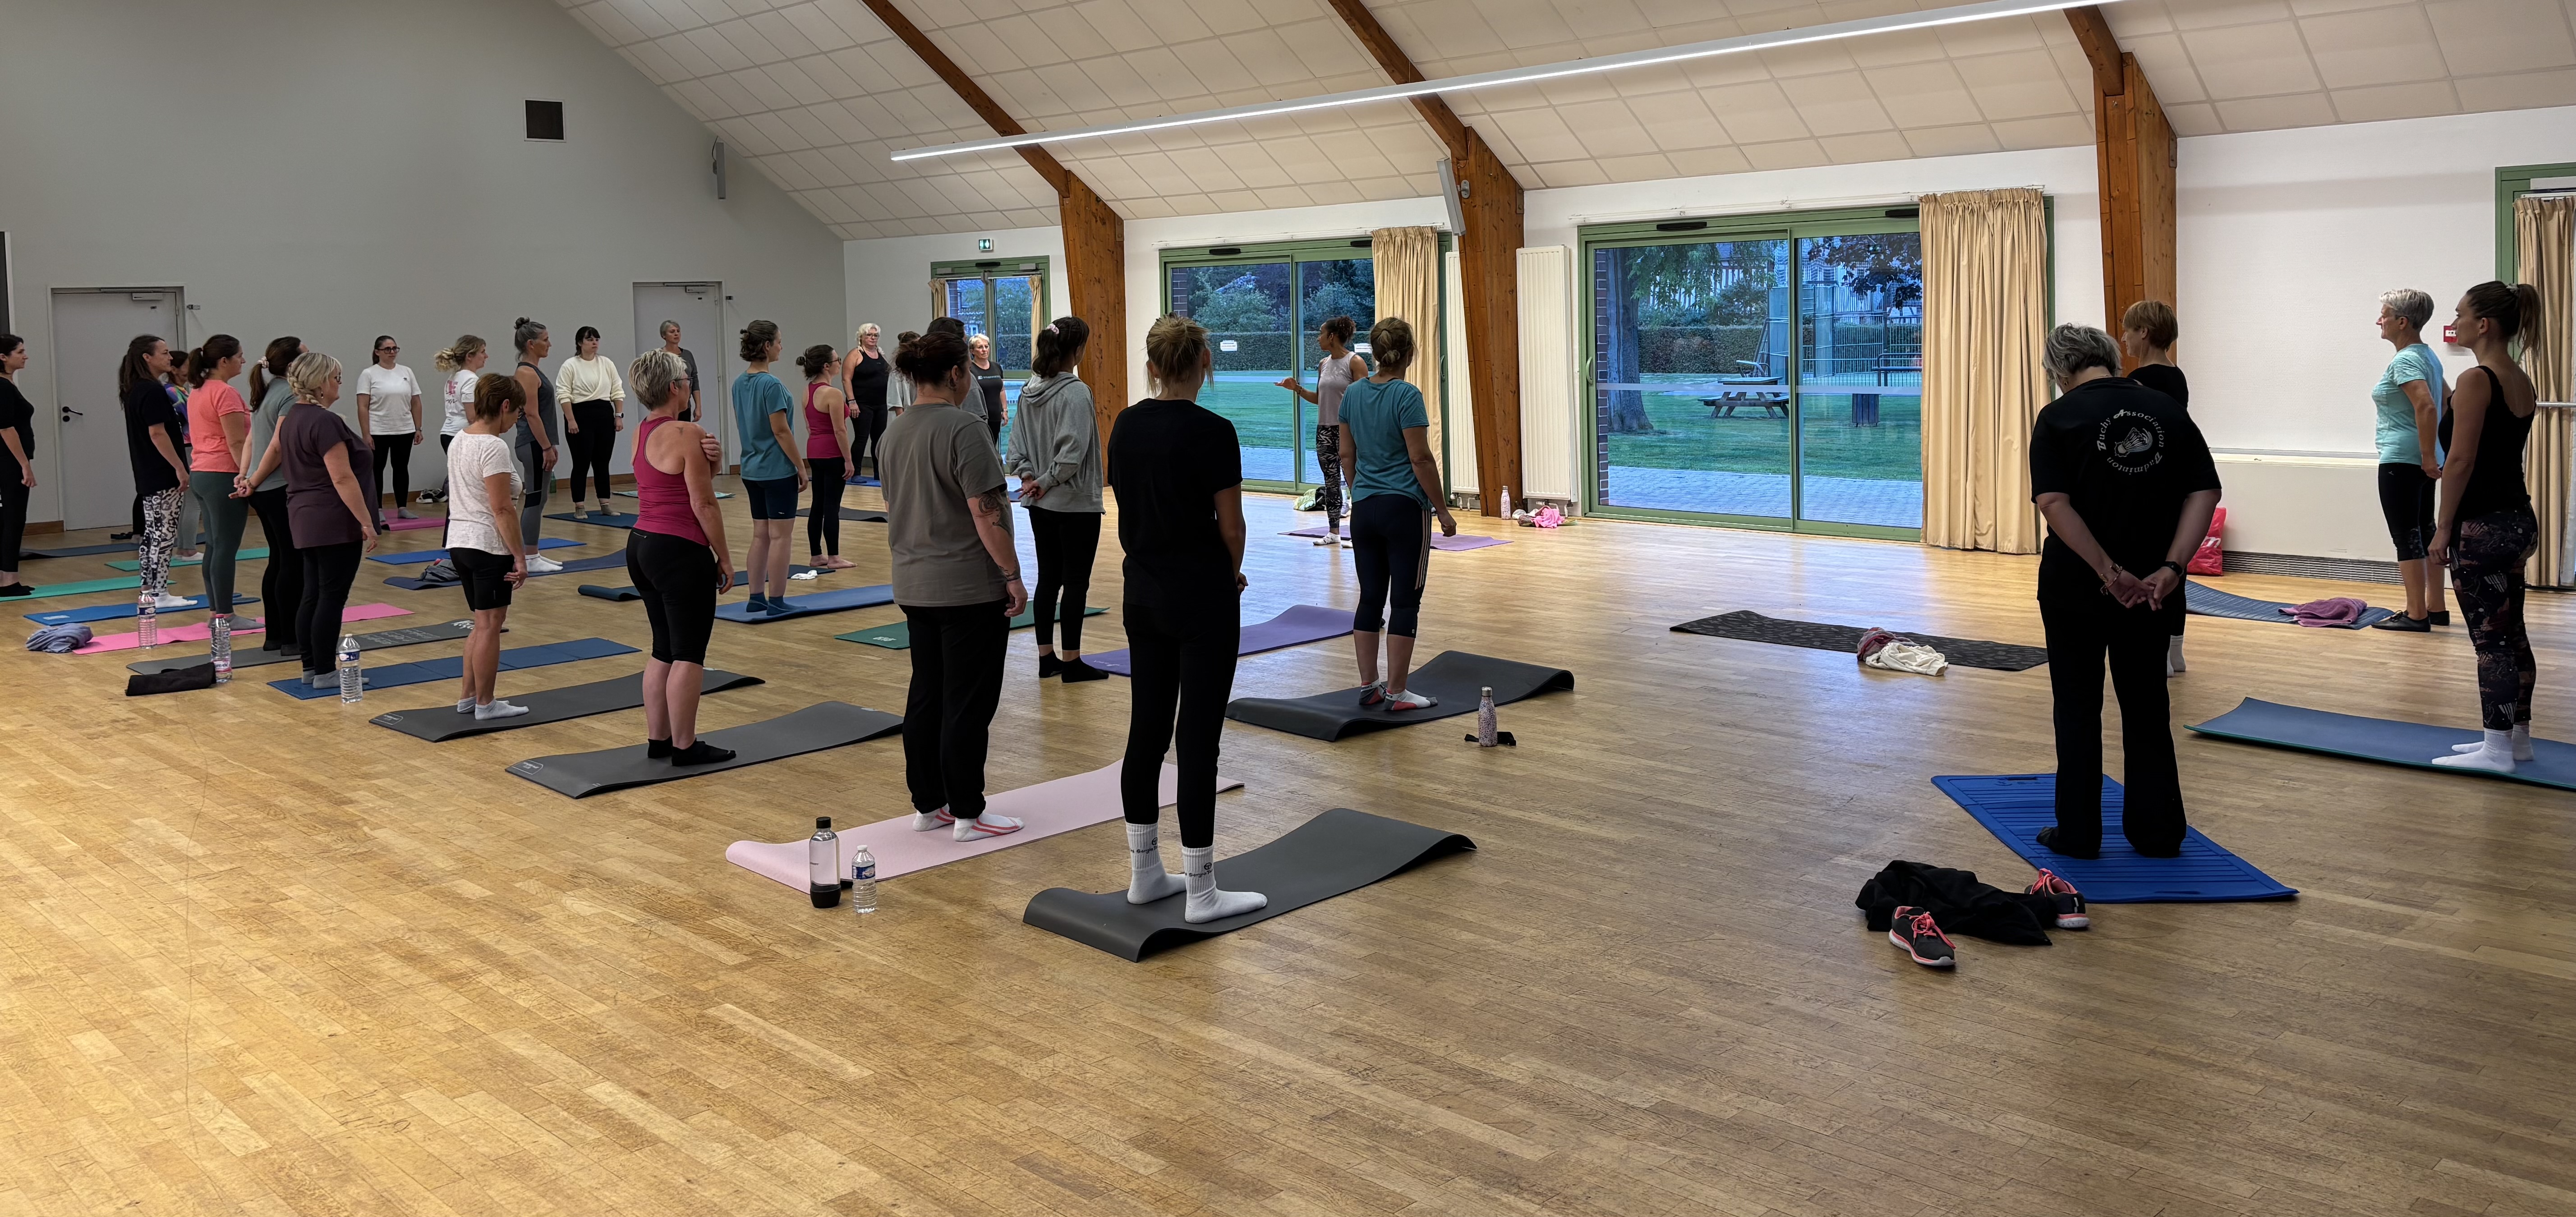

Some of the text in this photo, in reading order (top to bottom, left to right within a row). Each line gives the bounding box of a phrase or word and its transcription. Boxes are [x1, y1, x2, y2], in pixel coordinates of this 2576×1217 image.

[2097, 409, 2165, 475] Buchy Association Badminton
